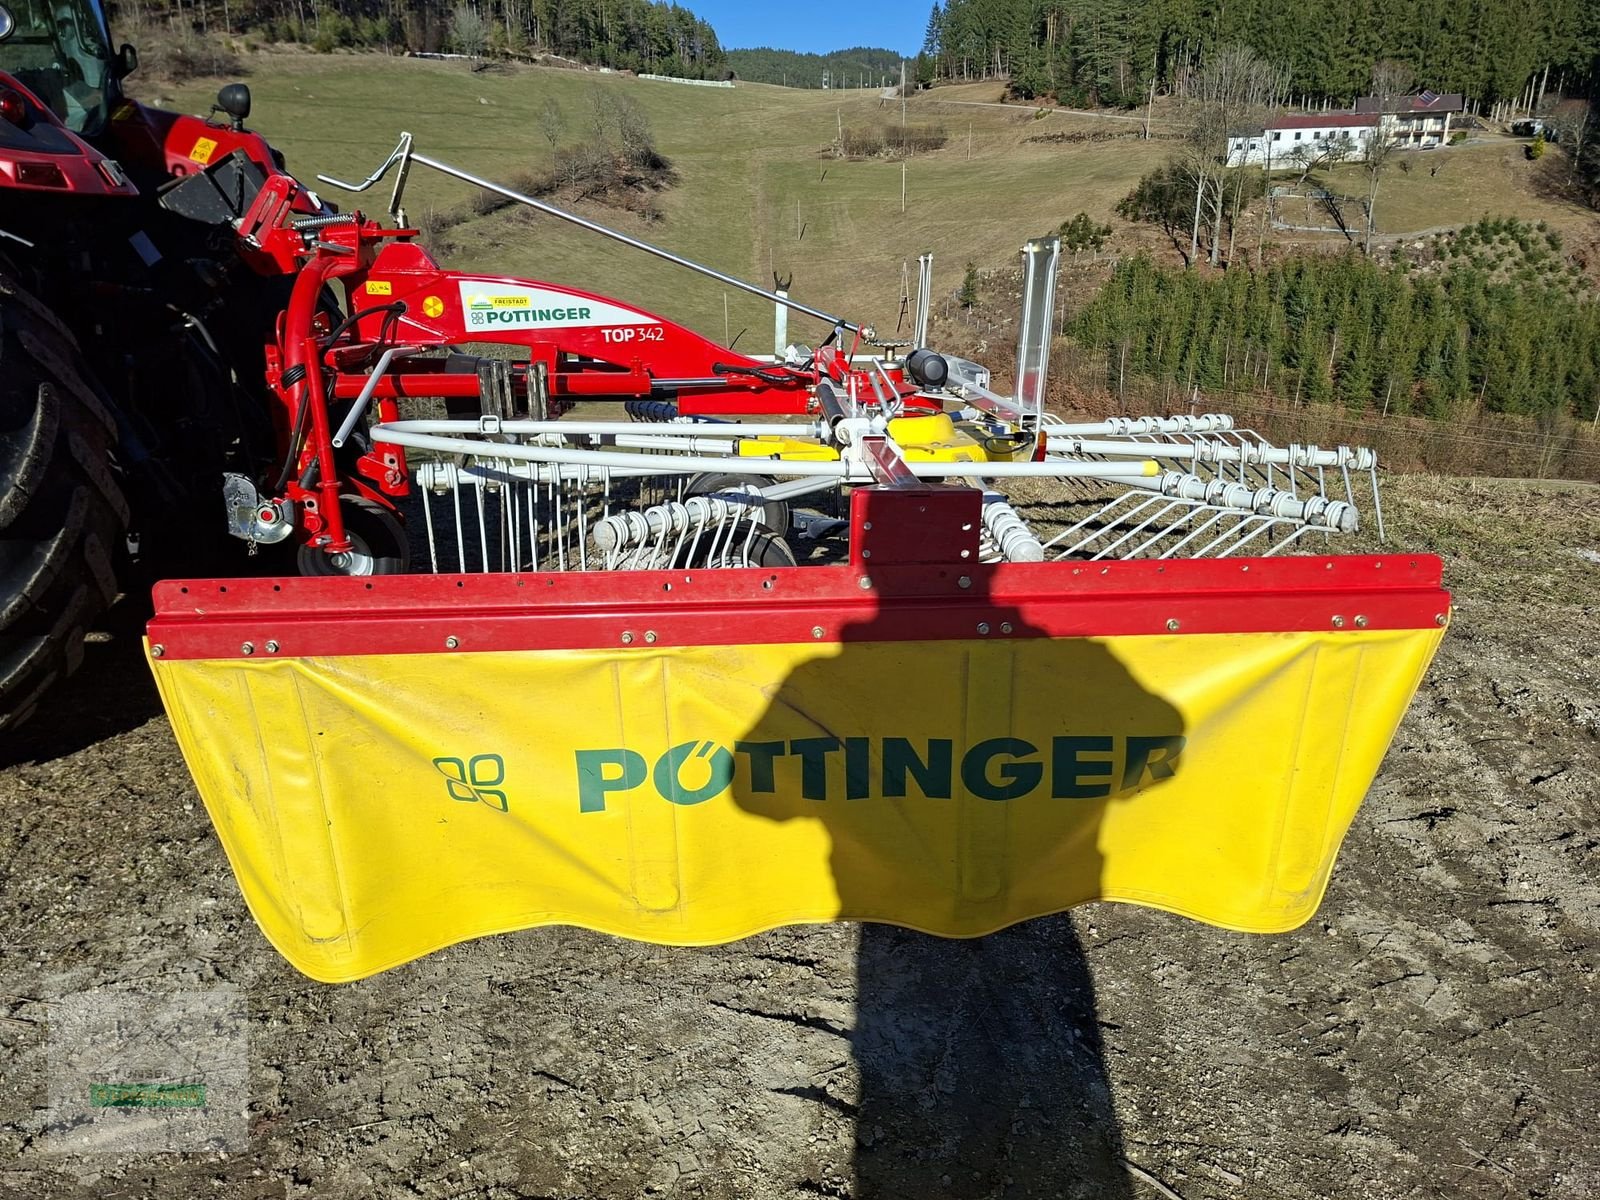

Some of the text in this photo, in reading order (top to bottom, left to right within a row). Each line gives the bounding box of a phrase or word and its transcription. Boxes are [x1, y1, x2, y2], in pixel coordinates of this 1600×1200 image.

[486, 307, 591, 324] PÖTTINGER
[601, 327, 665, 343] TOP 342
[575, 735, 1187, 813] PÖTTINGER
